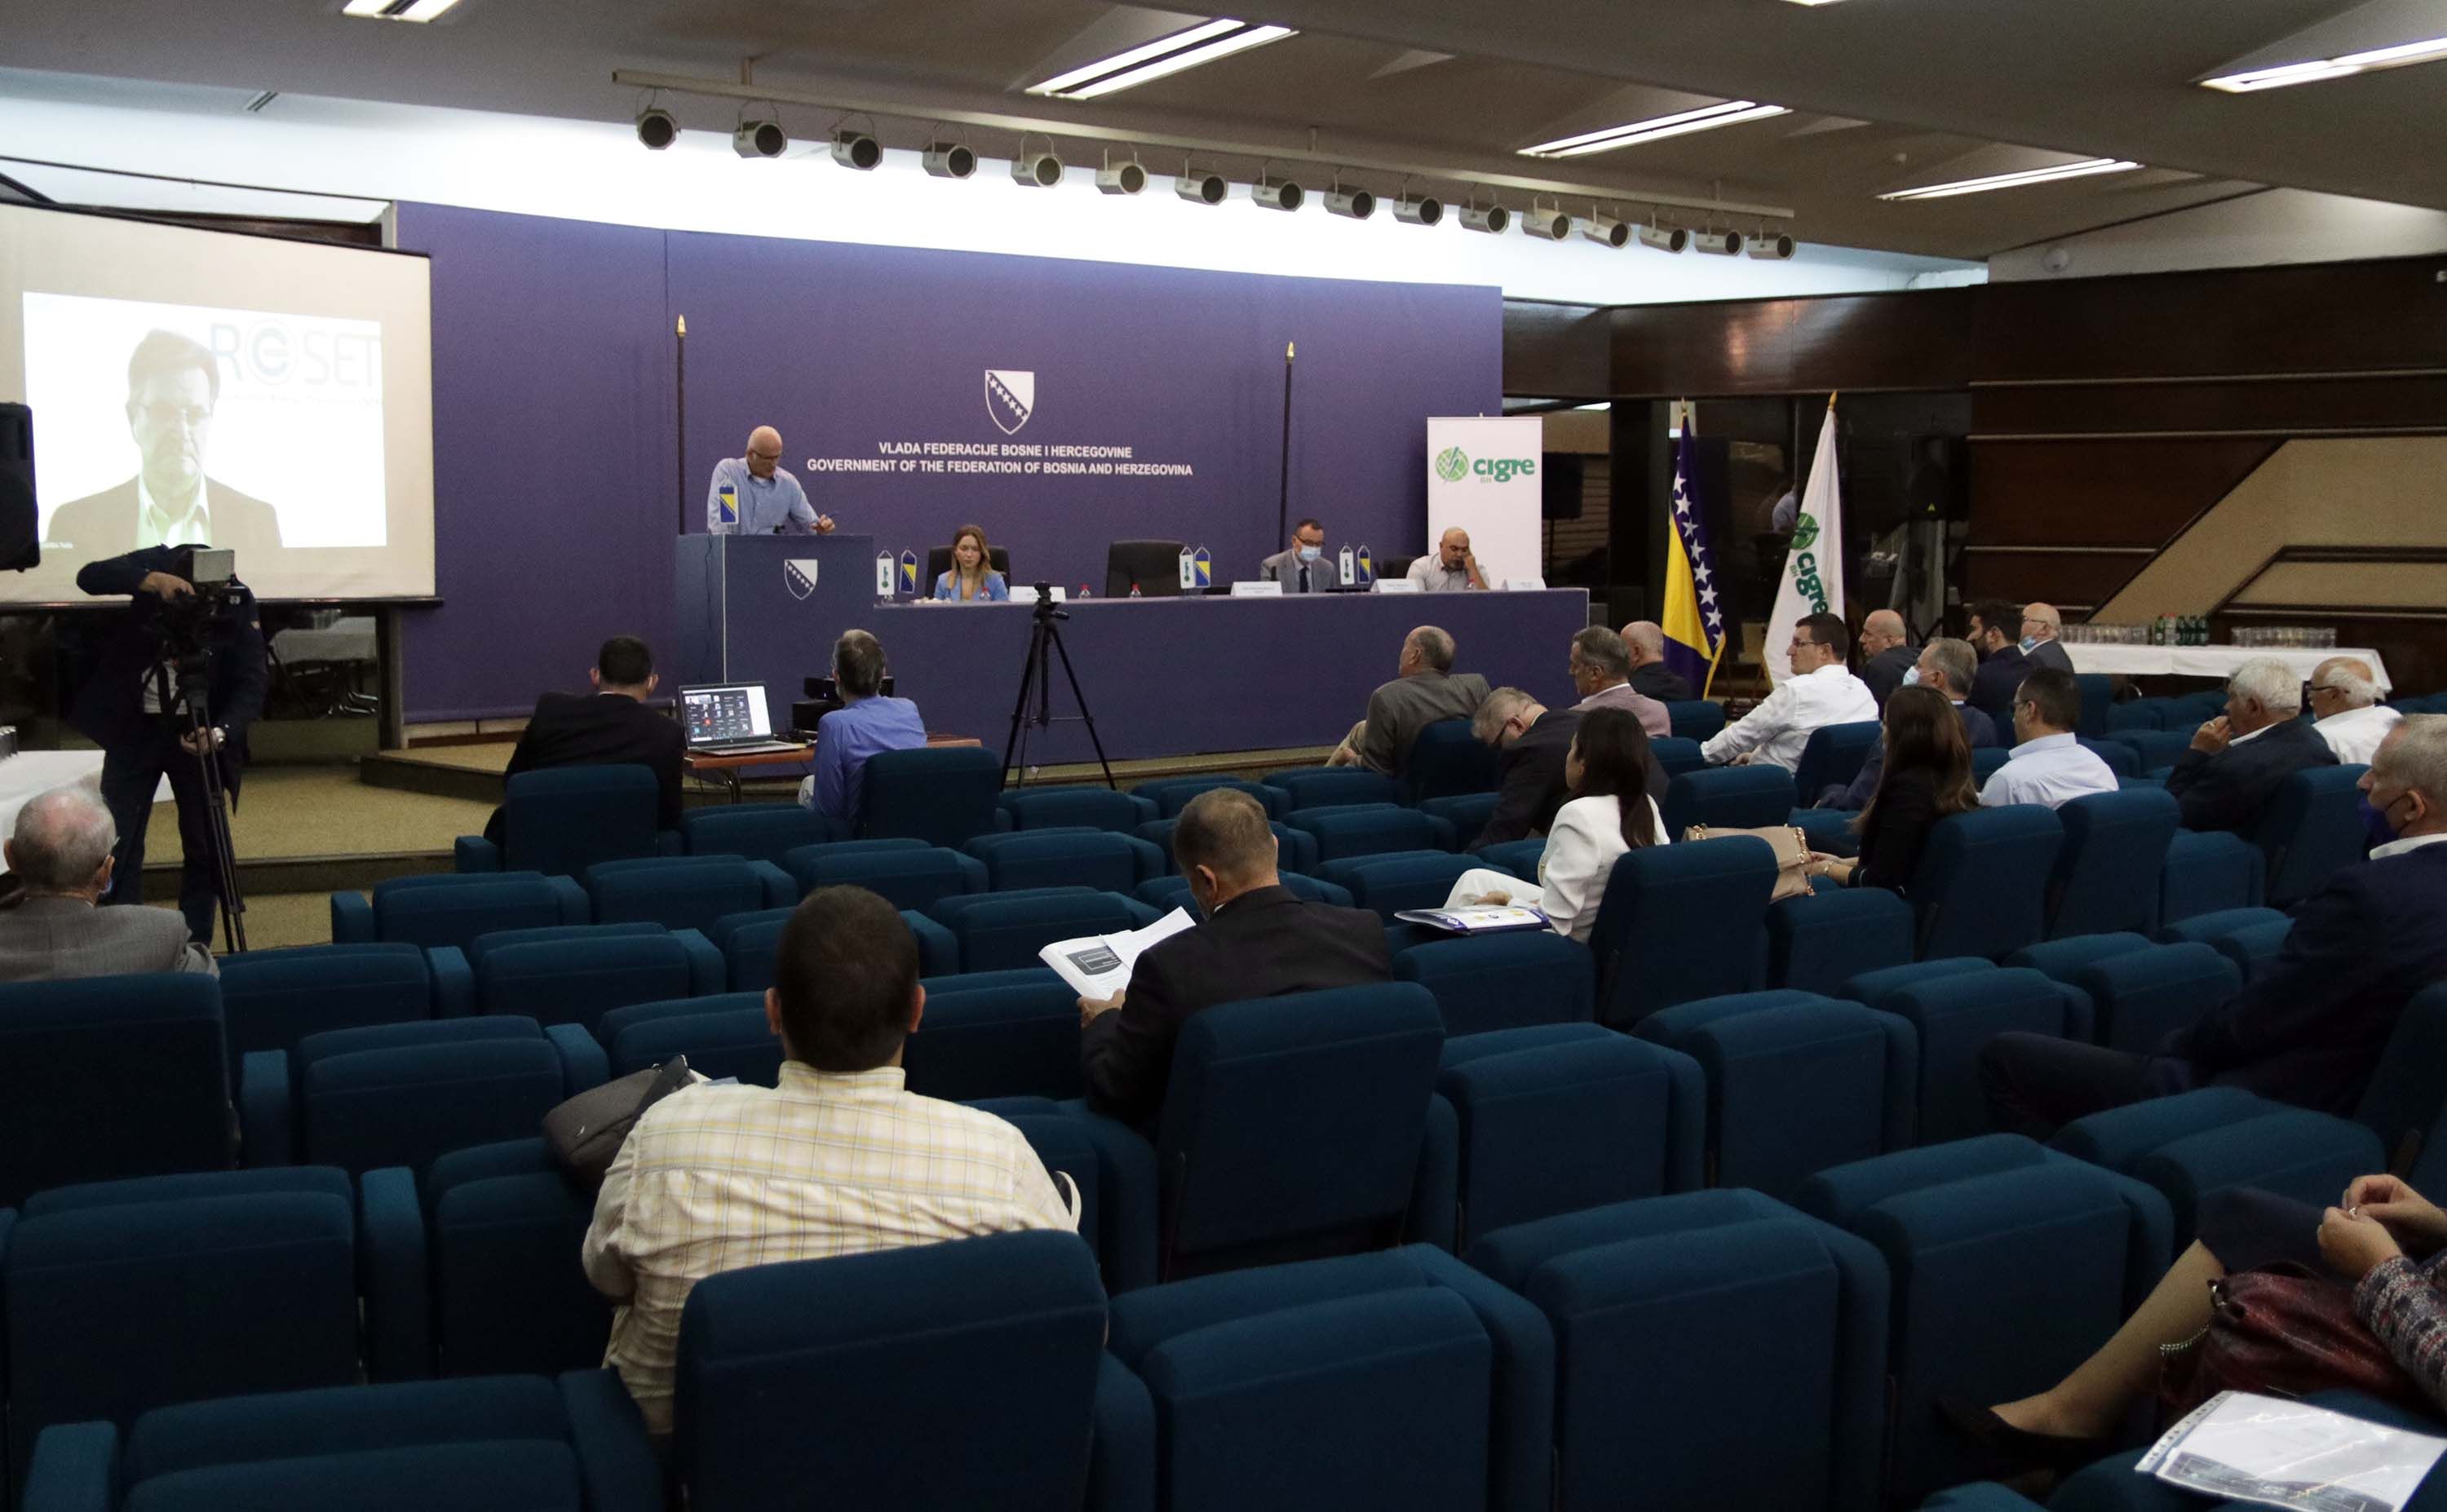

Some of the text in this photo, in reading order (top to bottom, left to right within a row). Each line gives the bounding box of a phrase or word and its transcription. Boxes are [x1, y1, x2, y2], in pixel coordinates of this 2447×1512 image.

[878, 442, 1132, 458] VLADA FEDERACIJE BOSNE I HERCEGOVINE
[807, 458, 1193, 475] GOVERNMENT OF THE FEDERATION OF BOSNIA AND HERZEGOVINA
[1473, 458, 1535, 482] cigre
[1795, 551, 1828, 615] cigre
